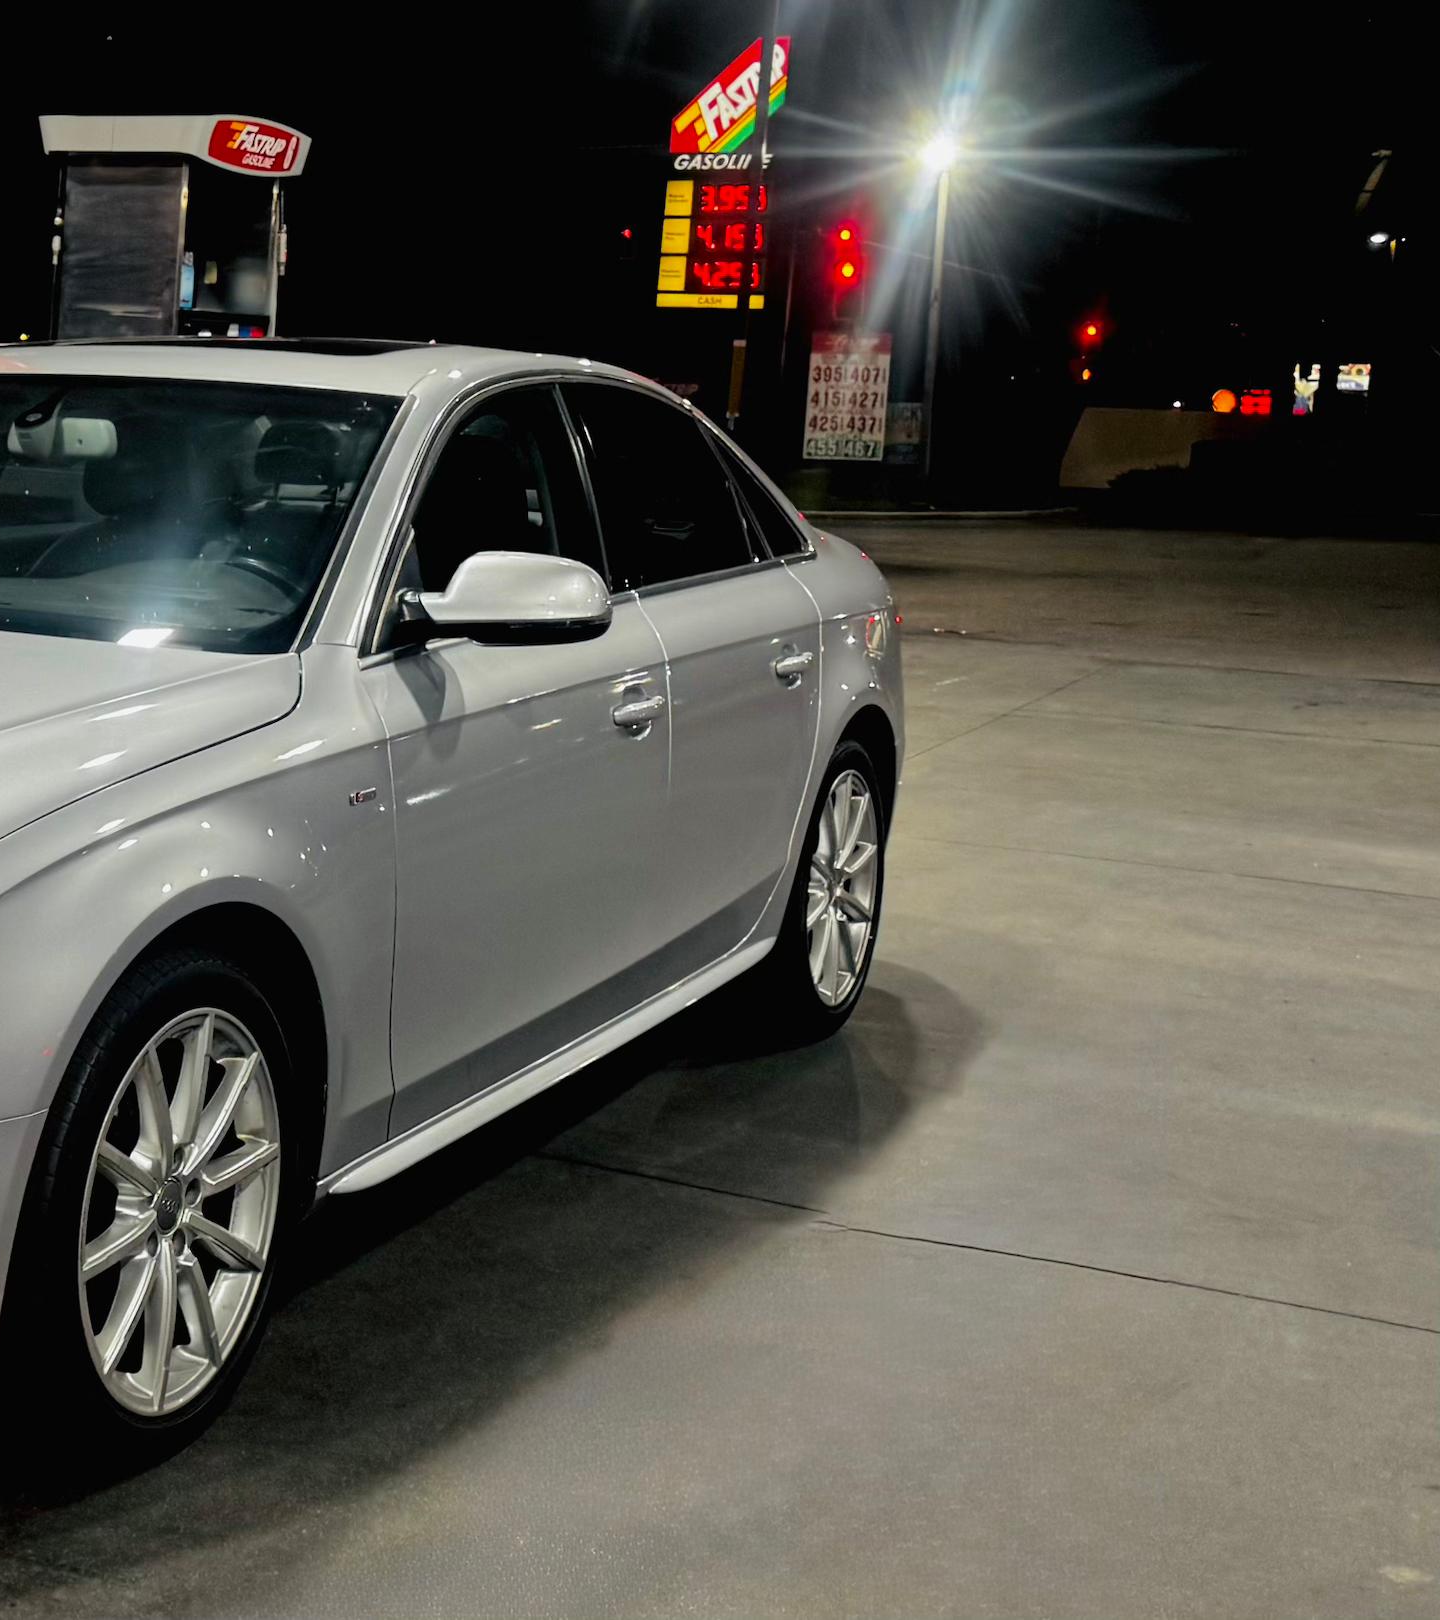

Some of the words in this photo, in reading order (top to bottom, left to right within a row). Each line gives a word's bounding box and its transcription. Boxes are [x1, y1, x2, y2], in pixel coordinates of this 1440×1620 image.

[232, 124, 287, 157] FASTRIP
[241, 153, 275, 169] GASOLINE
[698, 297, 722, 305] CASH
